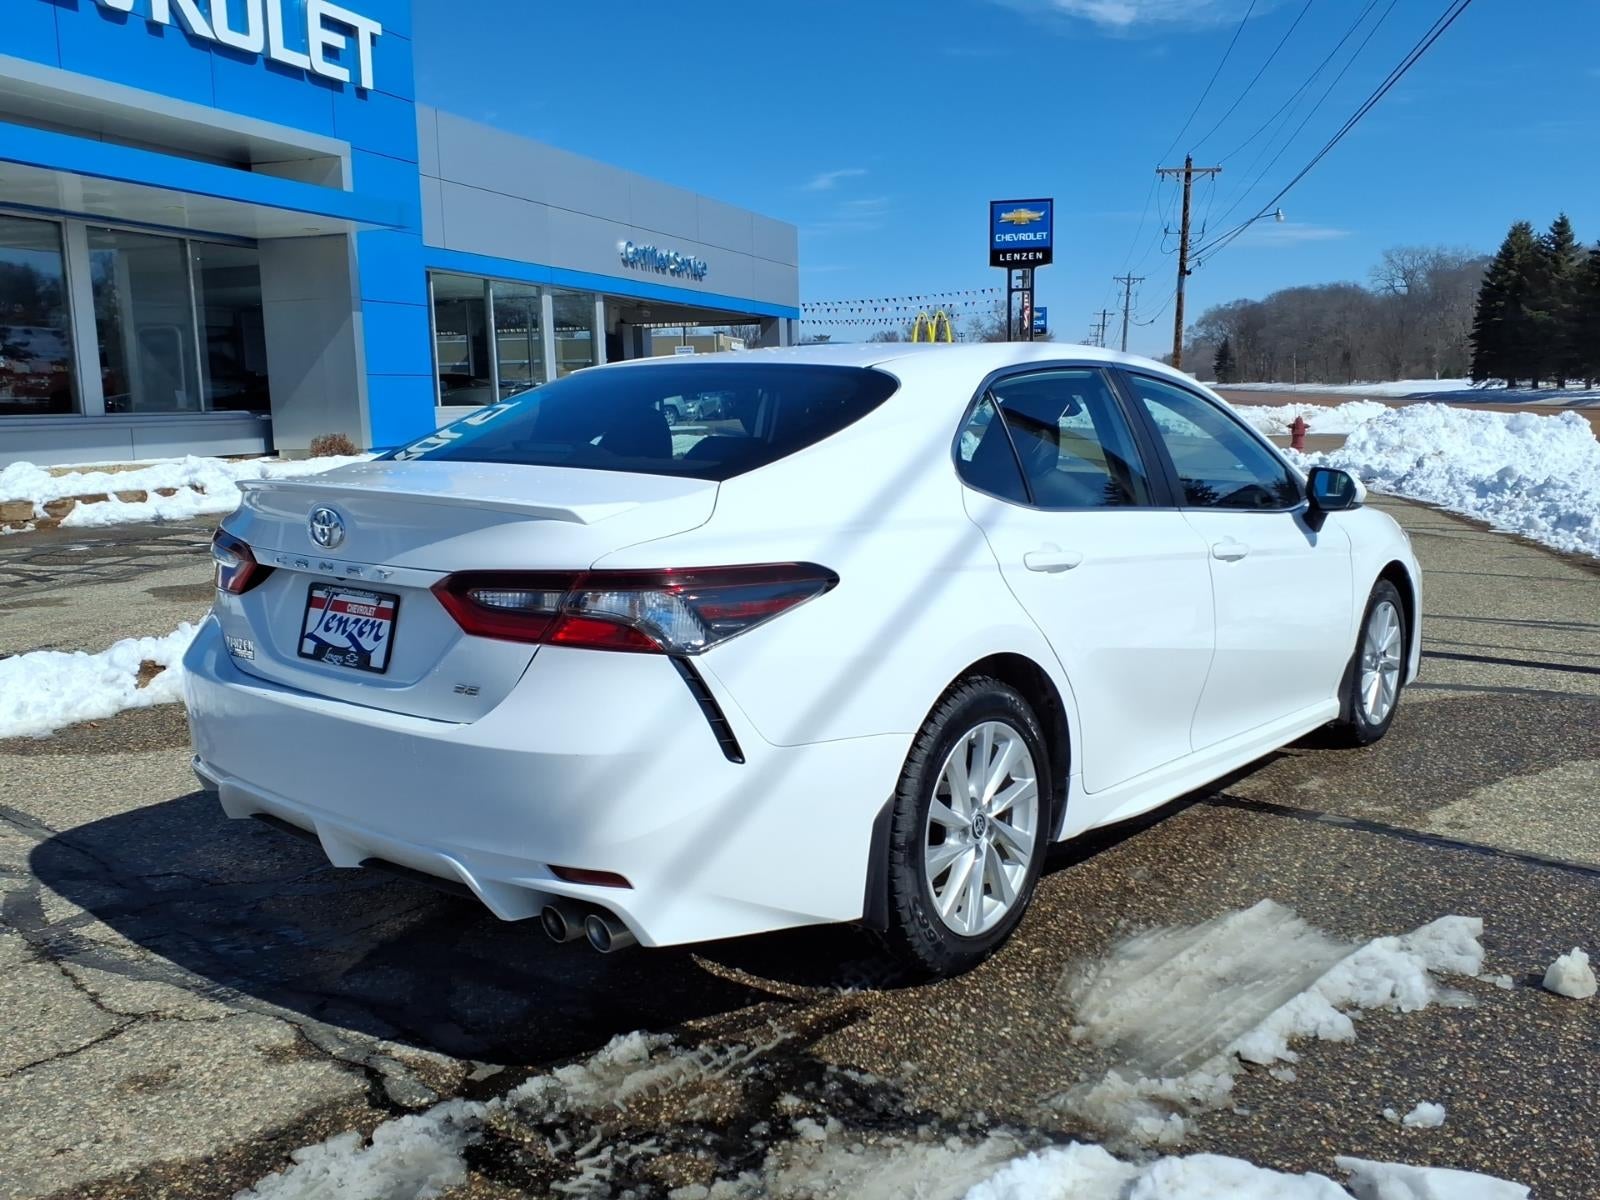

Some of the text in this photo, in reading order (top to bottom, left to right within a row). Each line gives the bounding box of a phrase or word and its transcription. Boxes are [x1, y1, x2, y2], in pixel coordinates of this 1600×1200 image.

[94, 0, 382, 90] OLET
[995, 232, 1048, 243] CHEVROLET
[620, 240, 708, 281] Certified Service
[999, 252, 1044, 262] LENZEN
[274, 556, 395, 579] CAMRY
[346, 603, 377, 616] CHEVROLET
[304, 592, 385, 652] Lenzen
[455, 683, 480, 696] SE
